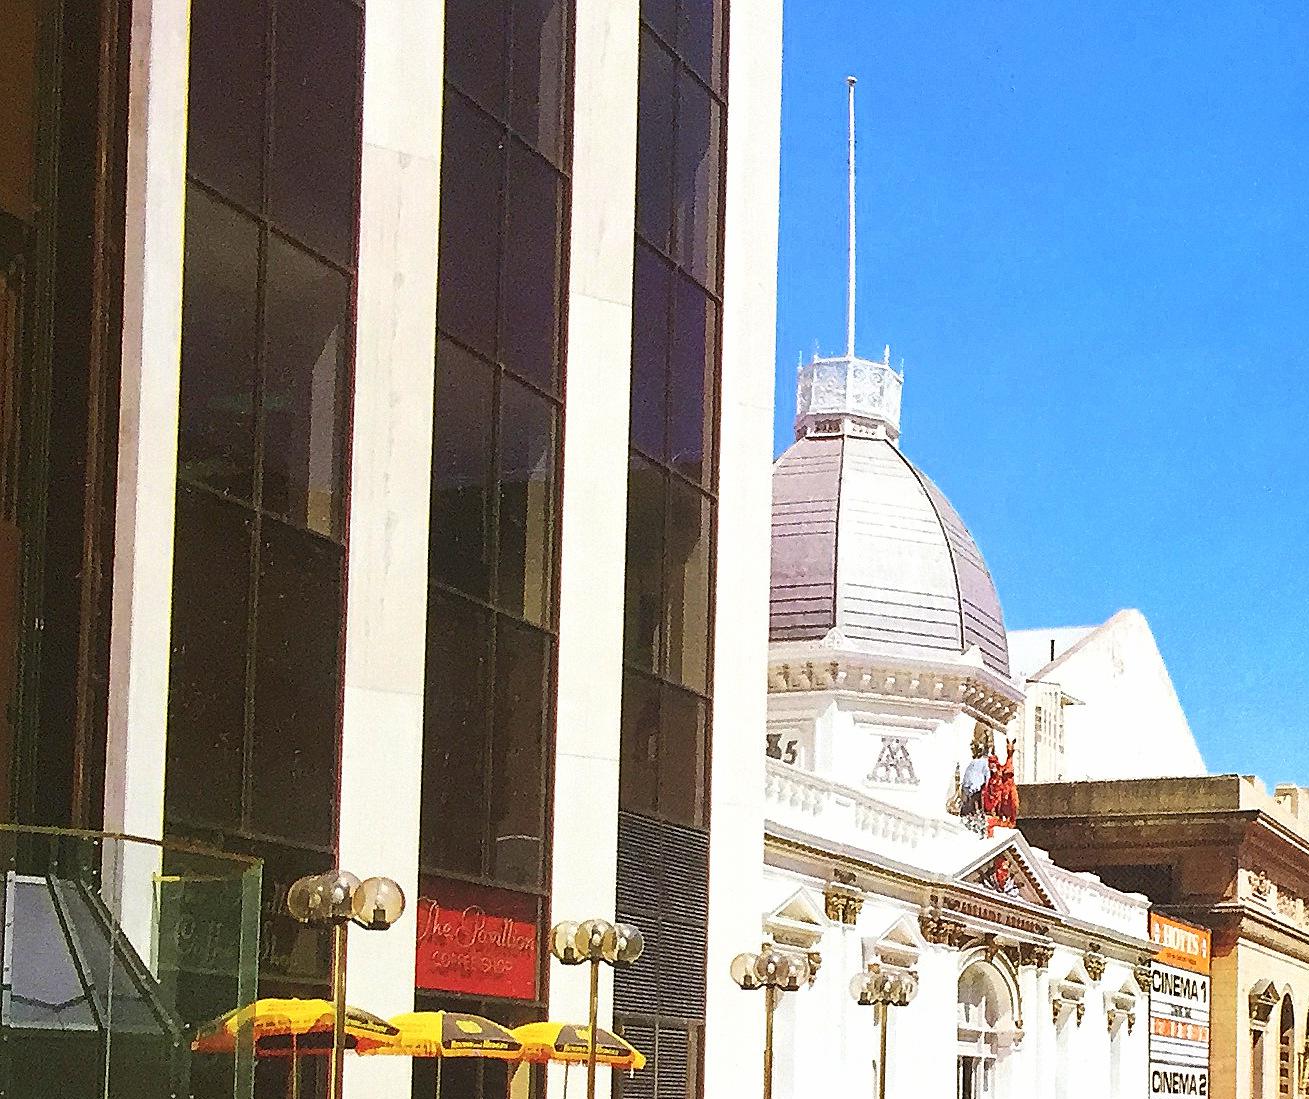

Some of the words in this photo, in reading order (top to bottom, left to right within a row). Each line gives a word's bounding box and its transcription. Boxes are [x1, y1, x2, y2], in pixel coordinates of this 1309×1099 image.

[418, 896, 455, 941] The
[1151, 968, 1199, 1001] CINEMA
[1200, 980, 1208, 1004] 1
[1151, 1069, 1198, 1096] CINEMA
[1199, 1073, 1207, 1096] 2
